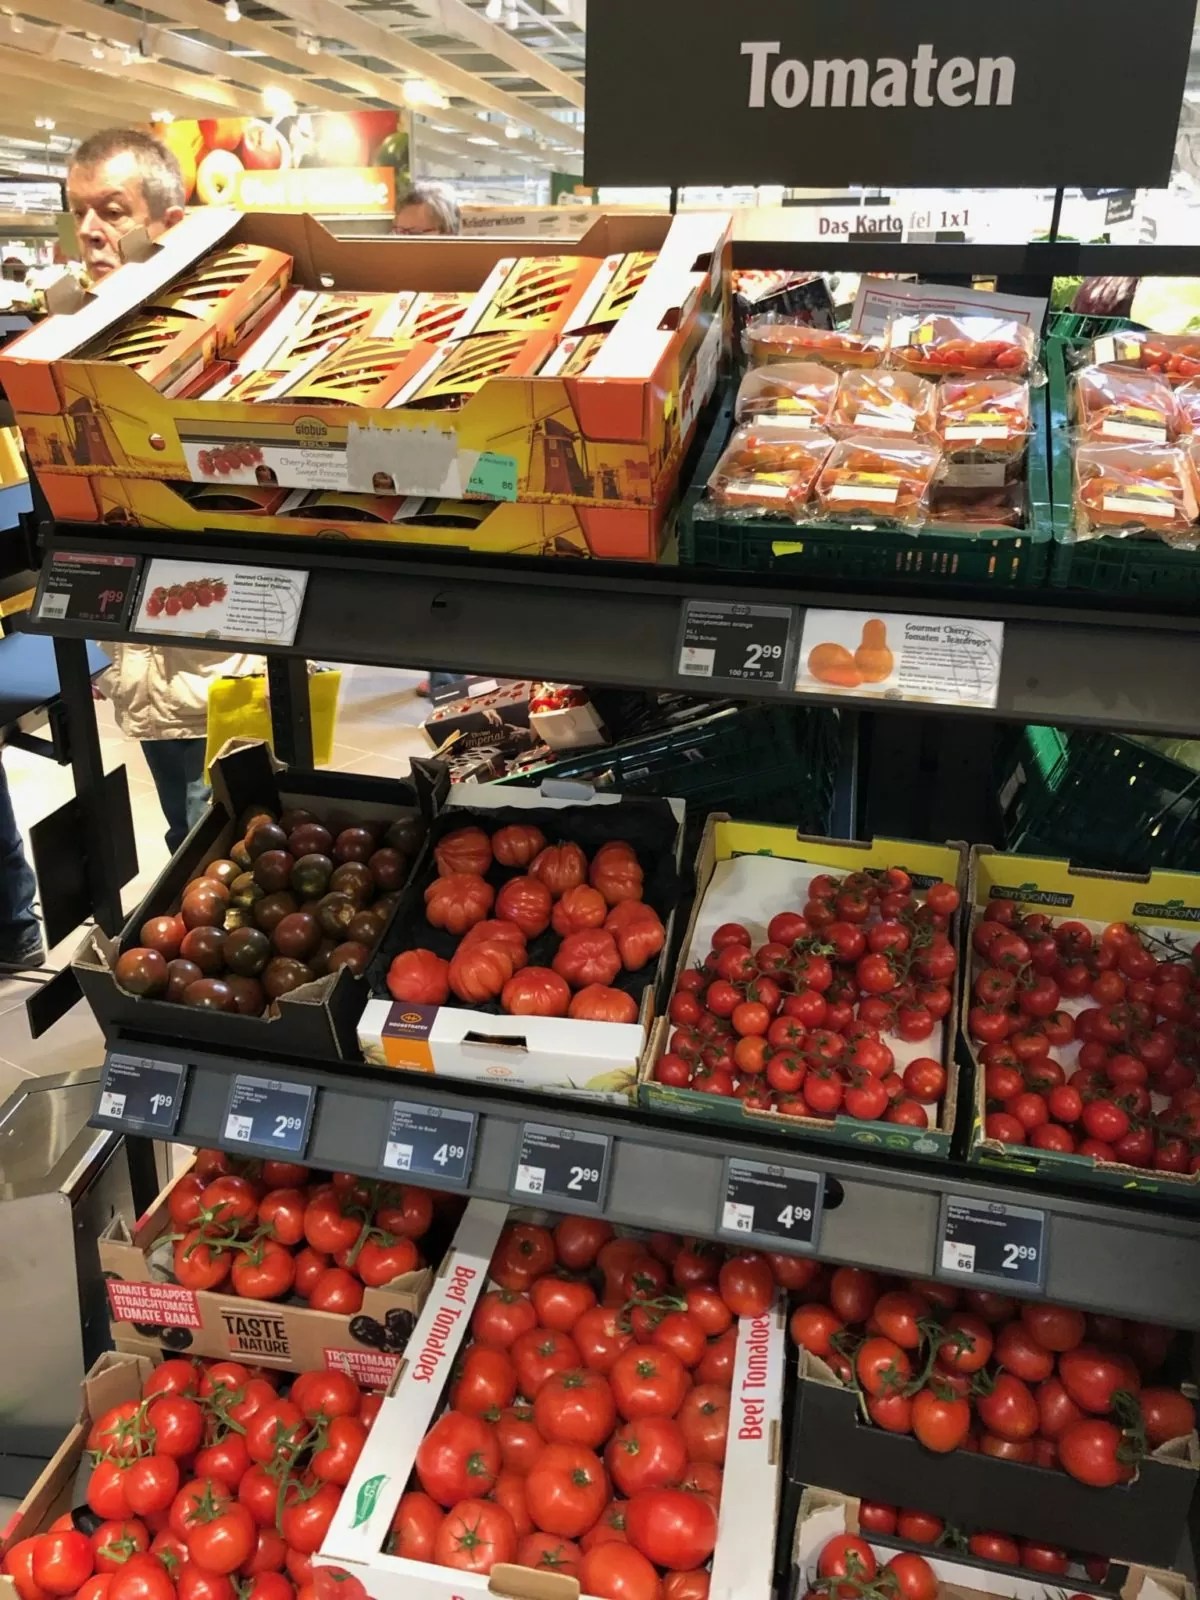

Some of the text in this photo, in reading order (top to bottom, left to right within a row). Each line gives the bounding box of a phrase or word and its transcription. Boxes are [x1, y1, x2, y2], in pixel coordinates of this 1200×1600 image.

[740, 41, 1016, 109] Tomaten
[819, 209, 969, 235] Das Kartofel 1x1
[502, 481, 513, 490] 80
[905, 621, 941, 633] Gourmet
[904, 631, 940, 643] Tomaten
[728, 668, 743, 676] 100
[110, 1106, 122, 1115] 65
[237, 1129, 248, 1139] 63
[396, 1157, 408, 1167] 64
[528, 1180, 541, 1191] 62
[737, 1219, 749, 1229] 61
[958, 1259, 971, 1269] 66
[110, 1283, 193, 1303] TOMATE GRAPPES
[113, 1295, 196, 1314] STRAUCHTOMATE
[117, 1306, 200, 1327] TOMATE RAMA
[221, 1314, 287, 1341] TASTE
[412, 1265, 476, 1384] Beef Tomatoes
[238, 1337, 291, 1354] NATURE
[738, 1312, 771, 1440] Beef Tomatoes
